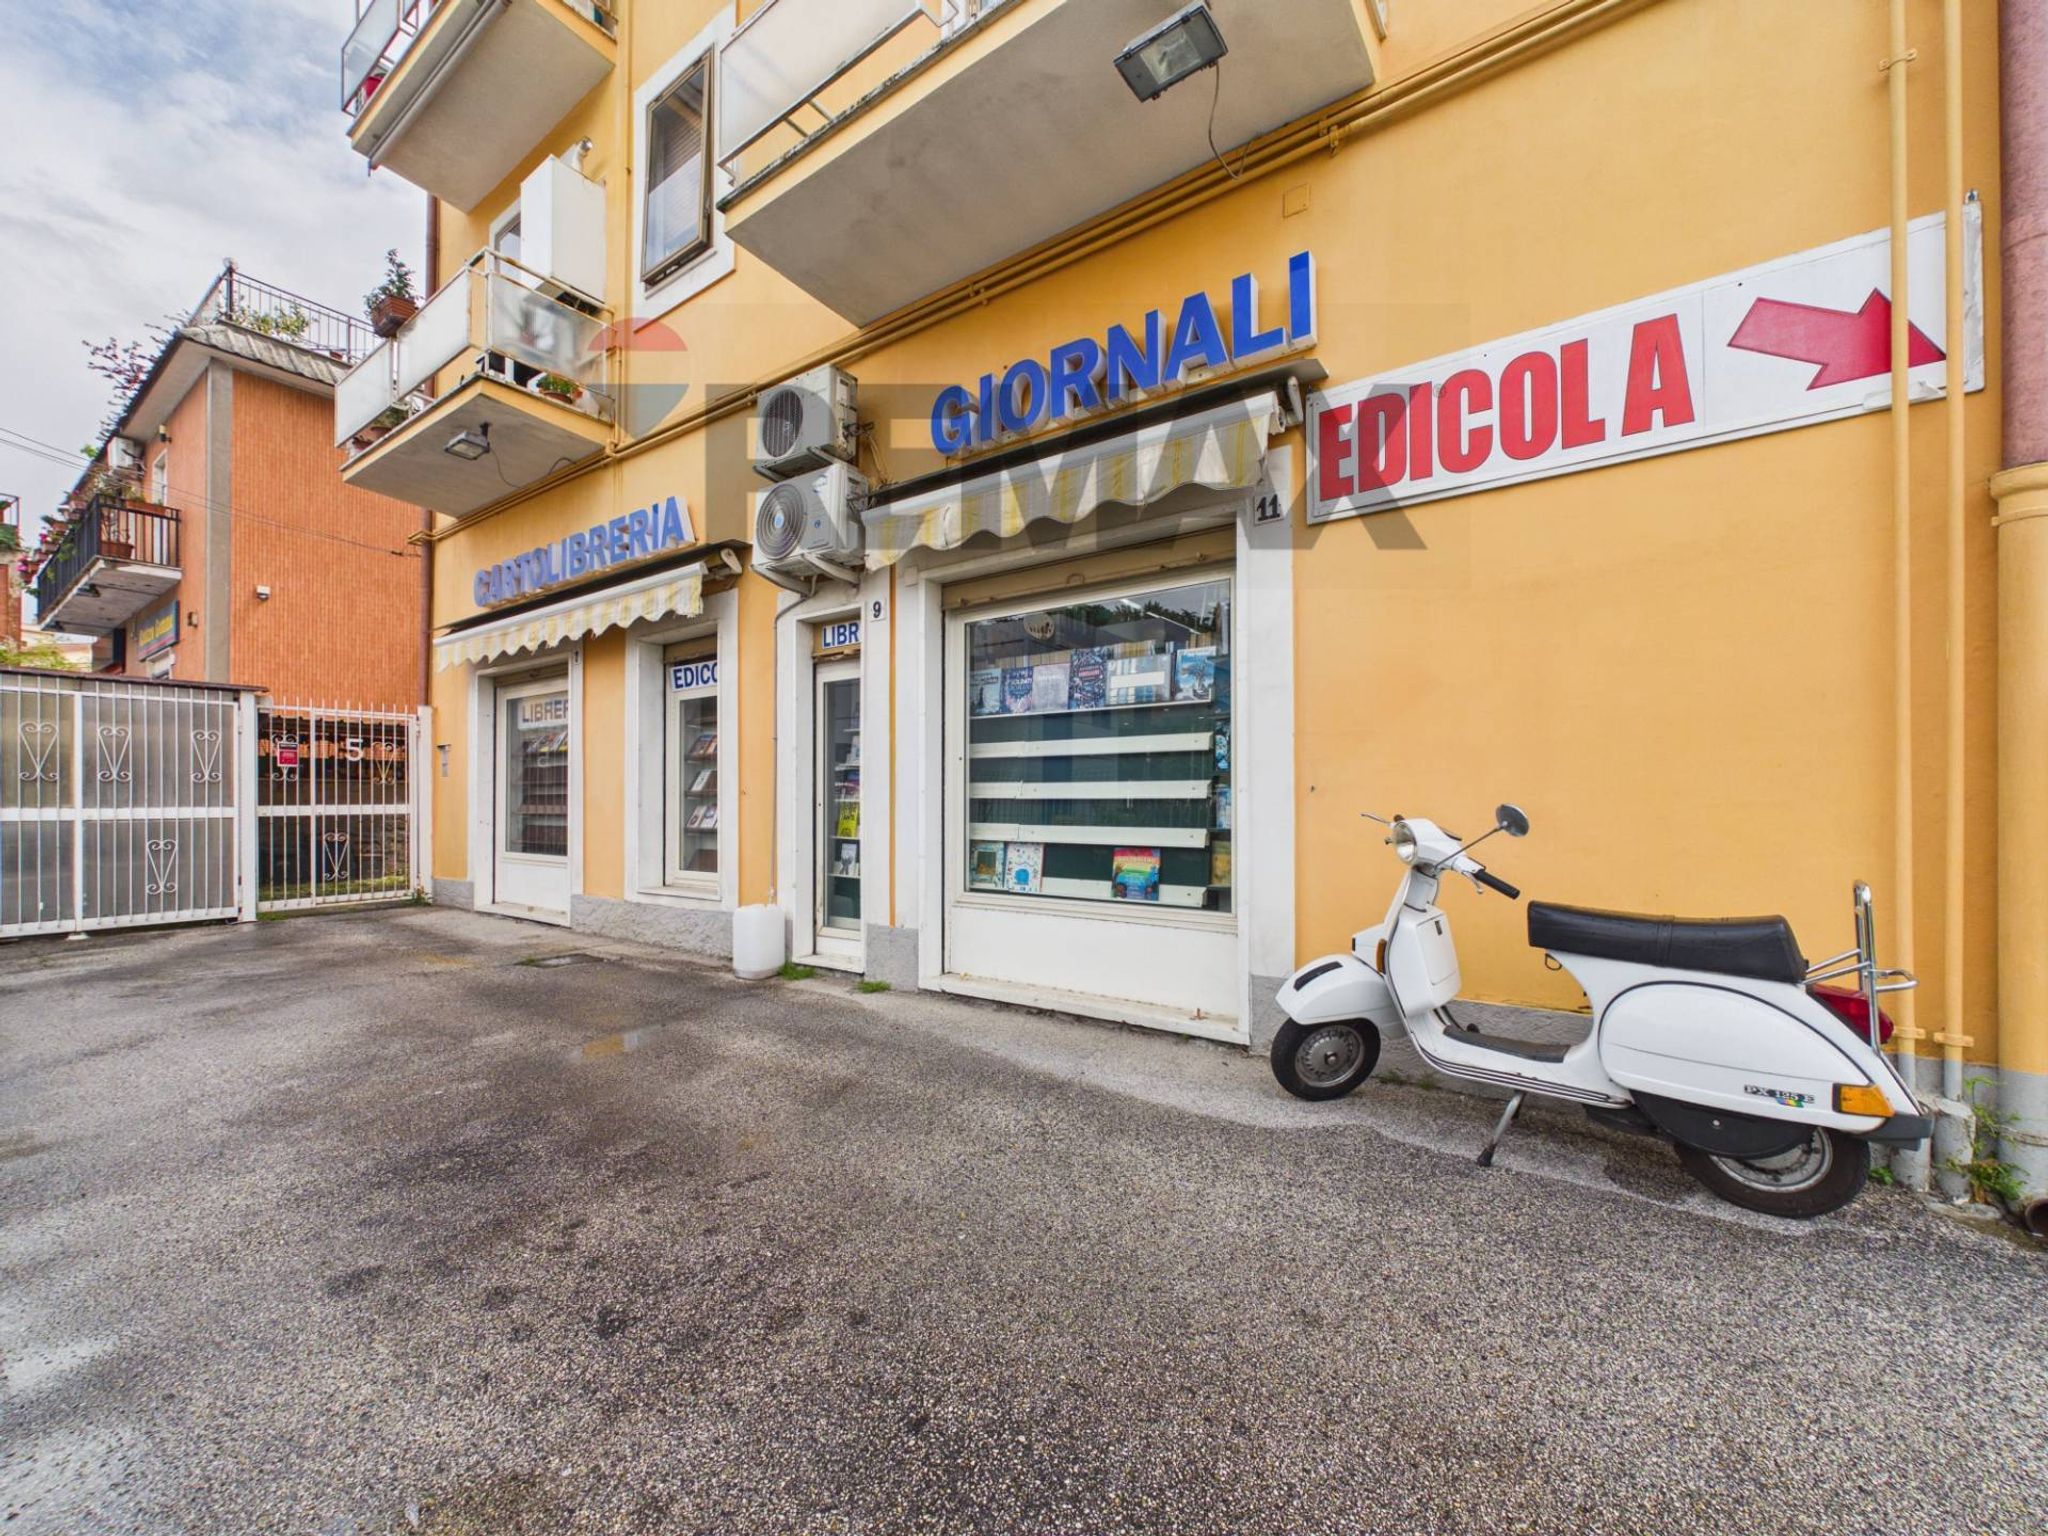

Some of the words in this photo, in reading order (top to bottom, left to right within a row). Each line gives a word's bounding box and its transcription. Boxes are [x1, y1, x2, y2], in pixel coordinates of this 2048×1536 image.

[931, 250, 1314, 456] GIORNALI
[1319, 313, 1696, 502] EDICOLA
[1256, 494, 1280, 521] 11
[473, 496, 690, 608] CARTOLIBRERIA
[873, 600, 882, 619] 9
[823, 622, 860, 647] LIBR
[345, 738, 364, 761] 5
